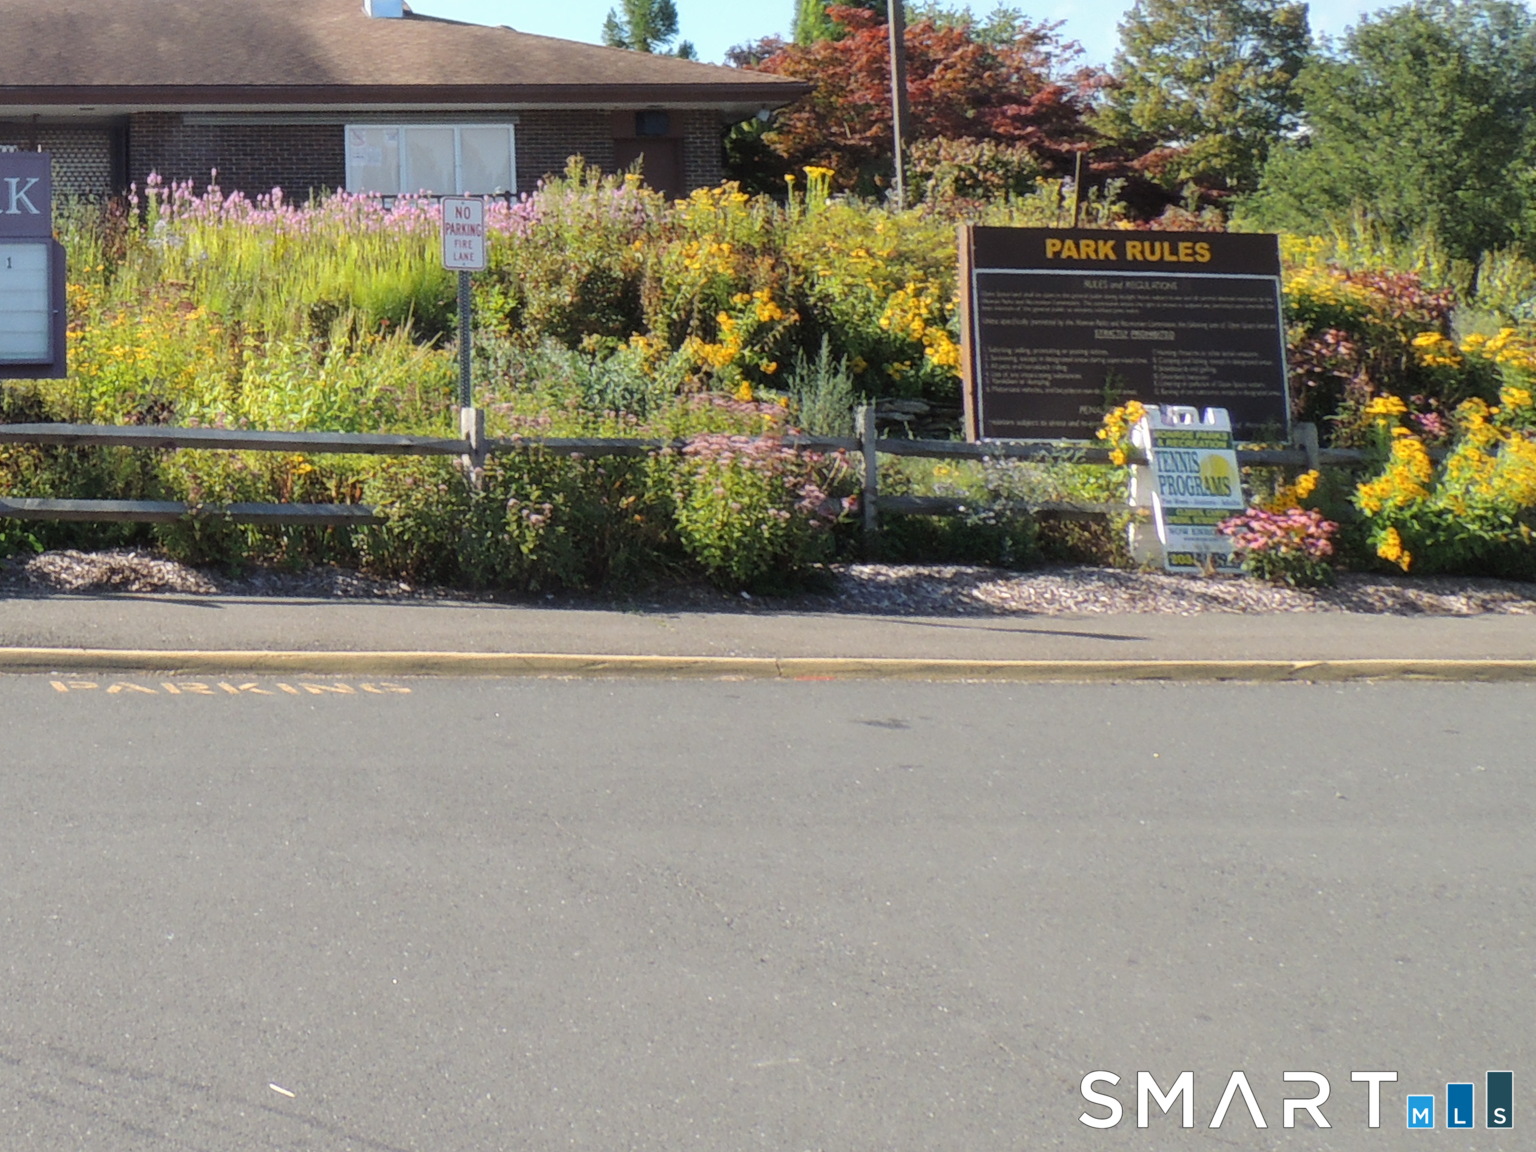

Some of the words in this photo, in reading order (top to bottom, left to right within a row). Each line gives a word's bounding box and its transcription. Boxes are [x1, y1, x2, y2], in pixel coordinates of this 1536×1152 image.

[455, 206, 471, 219] NO
[446, 222, 481, 237] PARKING
[454, 239, 473, 249] FIRE
[1045, 238, 1117, 261] PARK
[1125, 239, 1212, 263] RULES
[453, 252, 475, 262] LANE
[1154, 450, 1201, 474] TENNIS
[1158, 474, 1232, 498] PROGRAMS
[49, 680, 412, 695] PARKING
